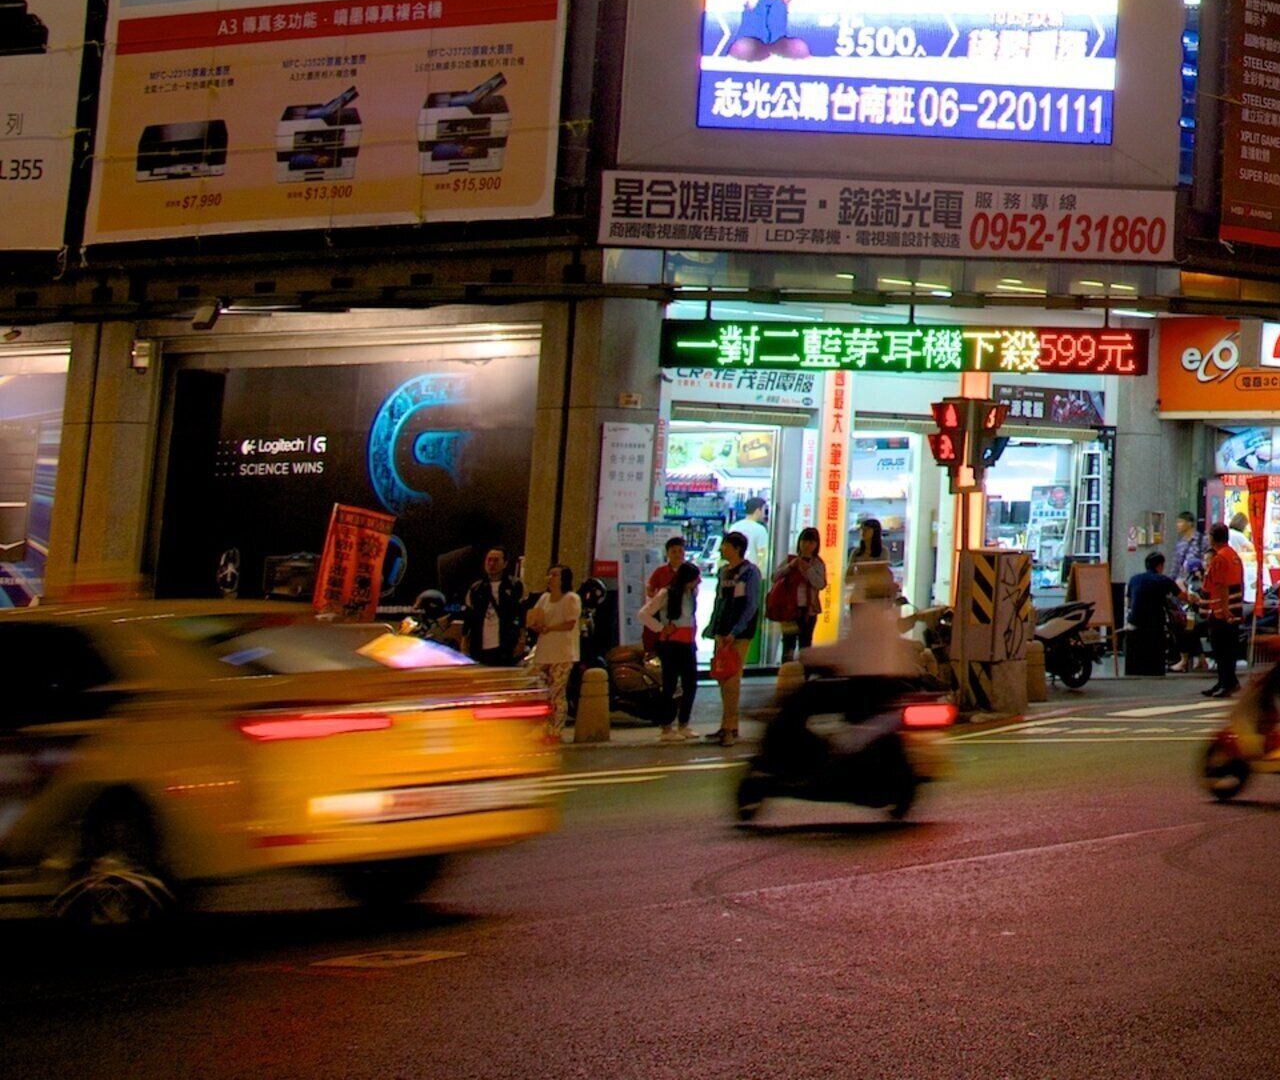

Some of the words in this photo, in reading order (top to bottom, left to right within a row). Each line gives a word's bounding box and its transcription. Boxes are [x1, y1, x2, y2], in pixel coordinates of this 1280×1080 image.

[217, 18, 238, 37] A3
[919, 86, 1103, 134] 06-2201111
[611, 179, 807, 226] 星合媒體廣告
[968, 210, 1168, 256] 0952-131860
[676, 324, 1136, 372] 一對二藍芽耳機下殺599元
[239, 461, 291, 477] SCIENCE
[291, 460, 325, 475] WINS
[258, 437, 305, 455] Logitech
